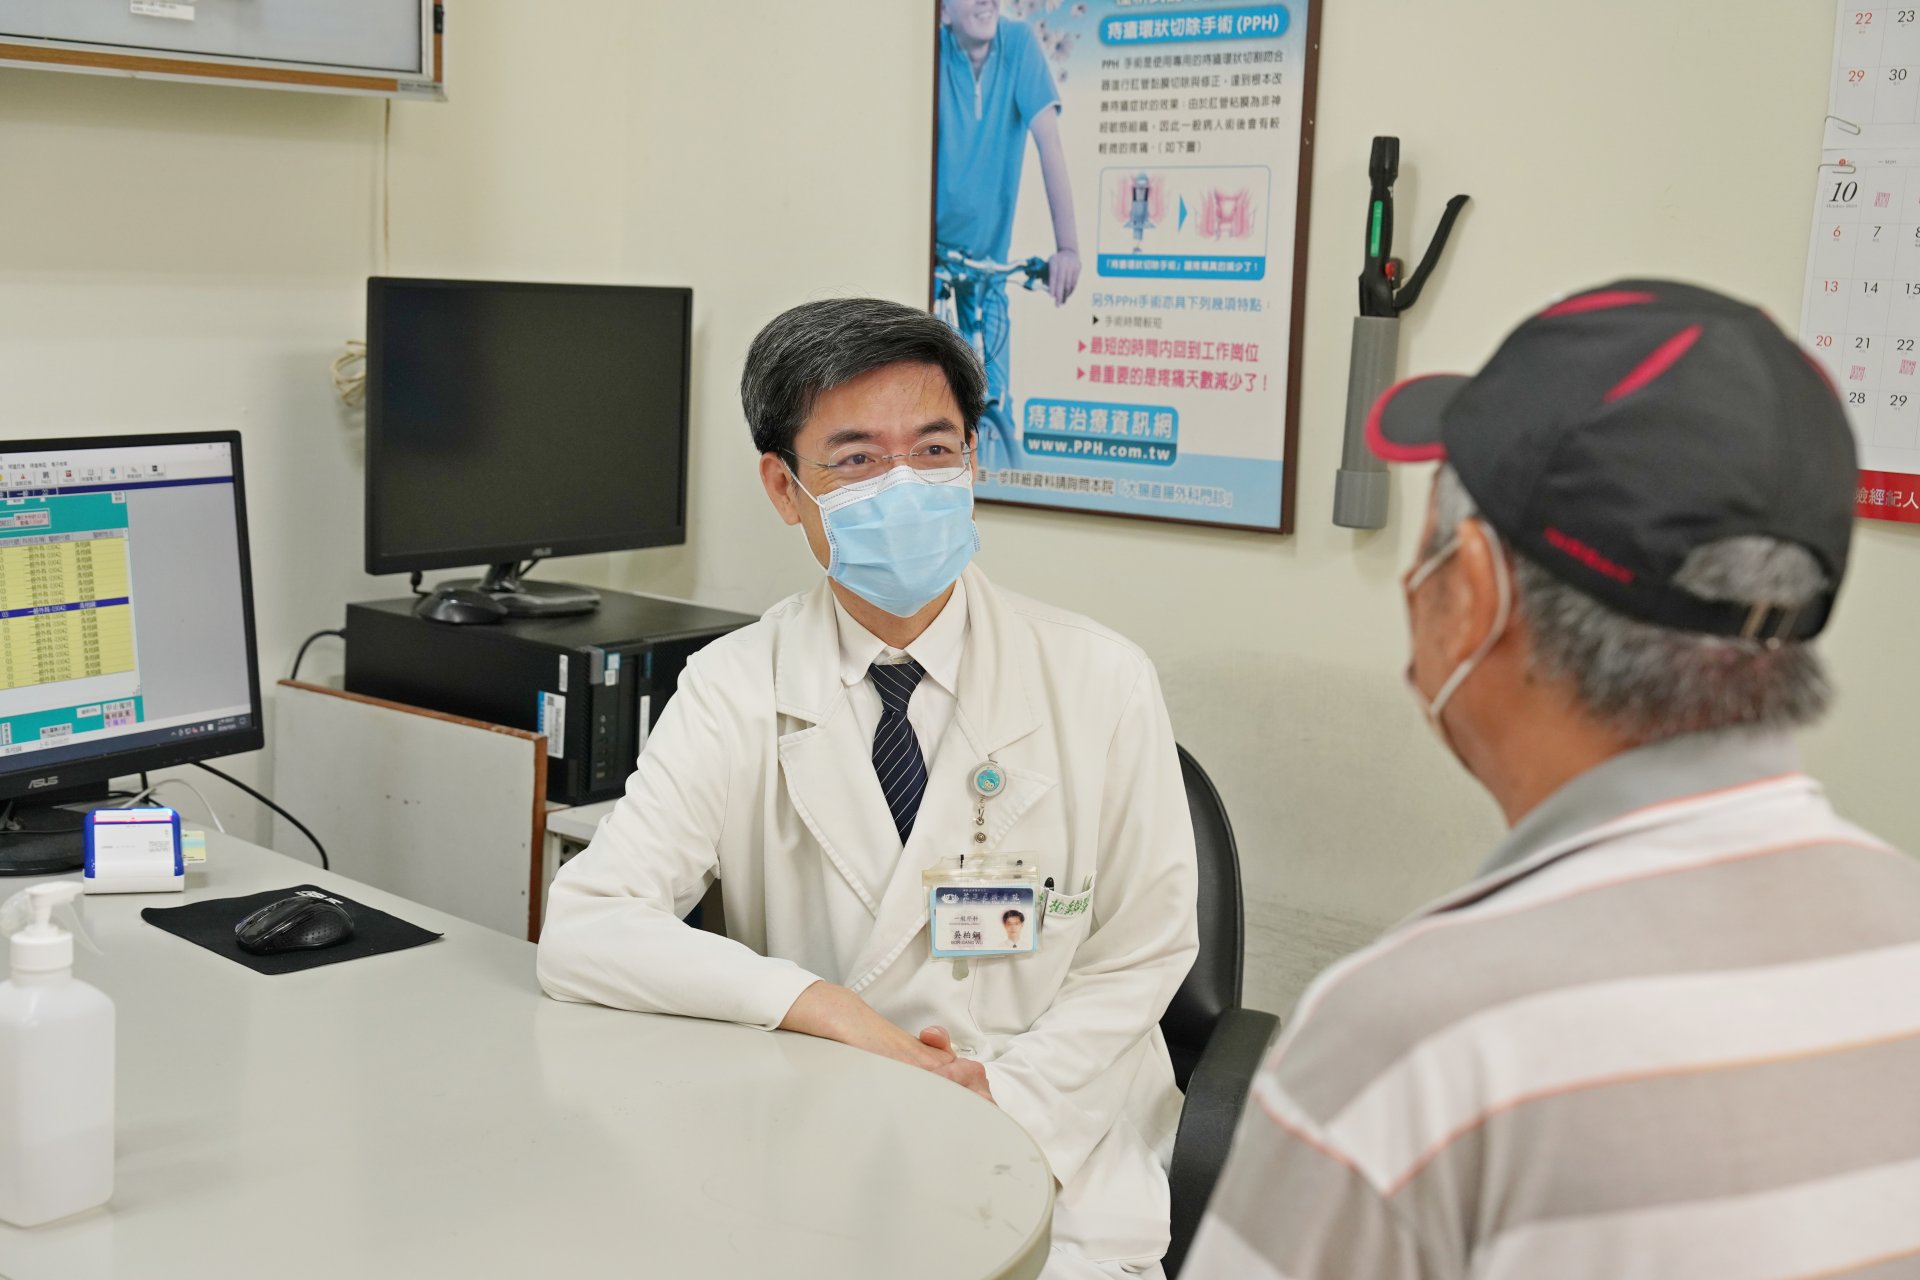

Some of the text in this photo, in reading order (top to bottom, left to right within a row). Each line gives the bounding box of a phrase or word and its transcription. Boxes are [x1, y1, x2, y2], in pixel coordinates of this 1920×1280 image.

[1236, 13, 1279, 33] (PPH)
[1855, 10, 1915, 25] 22 23
[1848, 68, 1907, 82] 29 30
[1829, 181, 1858, 202] 10
[1833, 225, 1841, 237] 6
[1873, 226, 1881, 238] 7
[1824, 280, 1920, 295] 13 14 15
[1816, 335, 1915, 351] 20 21 22
[1849, 392, 1908, 406] 28 29
[1027, 404, 1173, 440] 痔瘡治療資訊網
[1027, 438, 1171, 461] www.PPH.com.tw
[28, 776, 59, 789] ASUS
